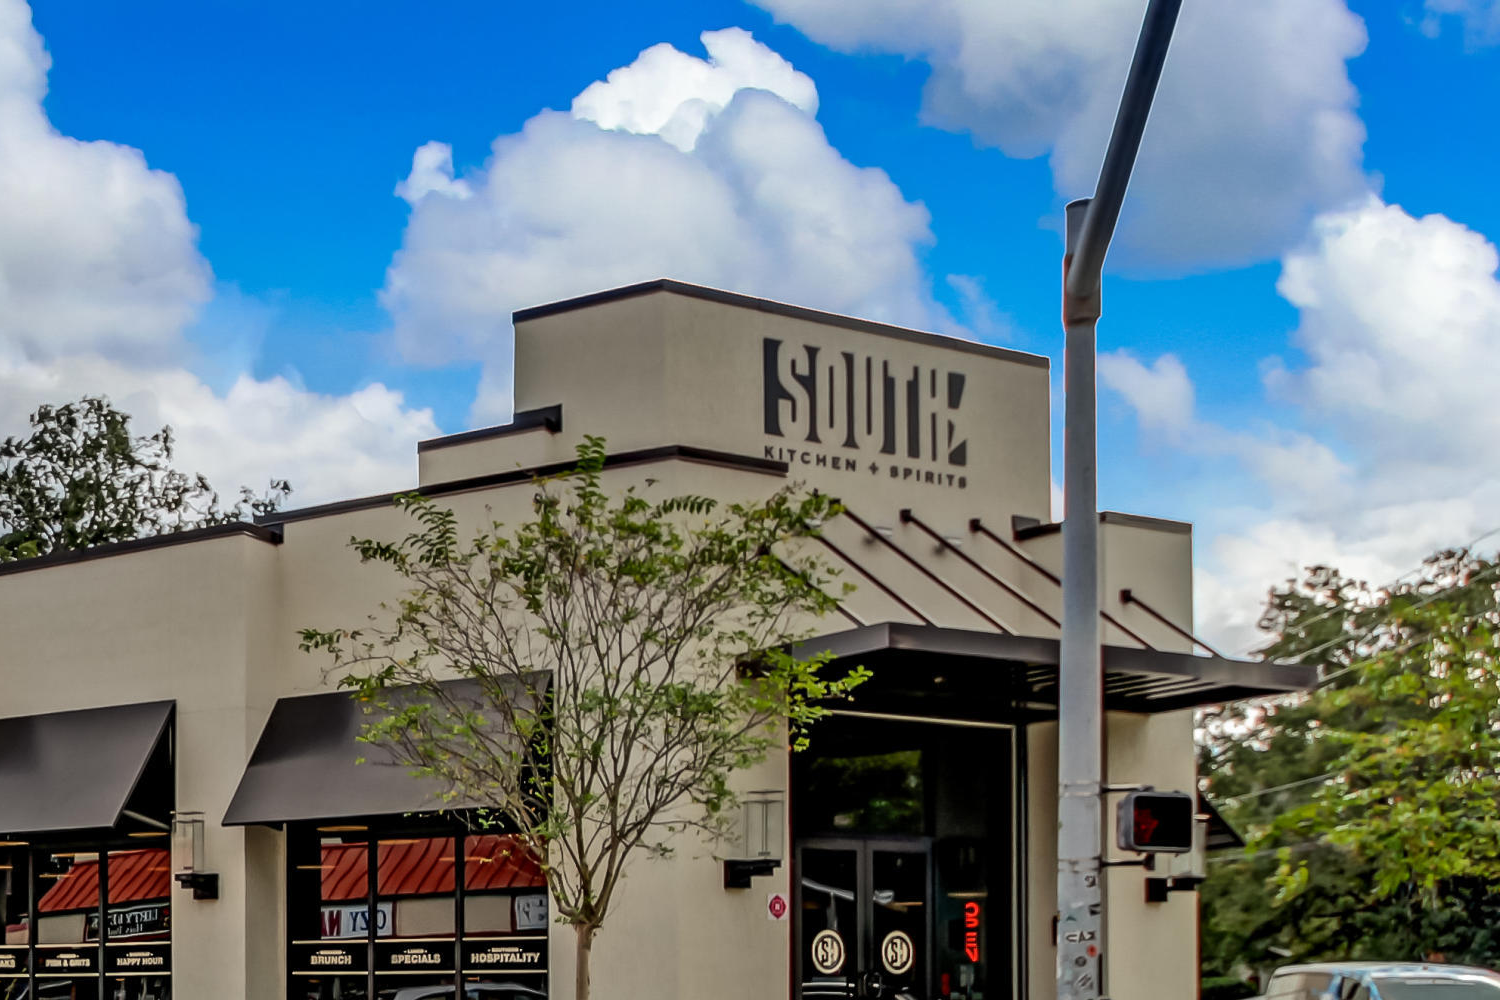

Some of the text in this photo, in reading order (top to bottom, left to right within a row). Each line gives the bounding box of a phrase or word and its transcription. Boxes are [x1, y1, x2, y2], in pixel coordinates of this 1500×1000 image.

[763, 337, 967, 467] SOUTH
[764, 445, 856, 473] KITCHEN
[890, 465, 967, 489] SPIRITS
[116, 956, 164, 966] HAPPY HOUR
[310, 955, 352, 965] BRUNCH
[391, 953, 441, 964] SPECIALS
[470, 952, 540, 964] HOSPITALITY
